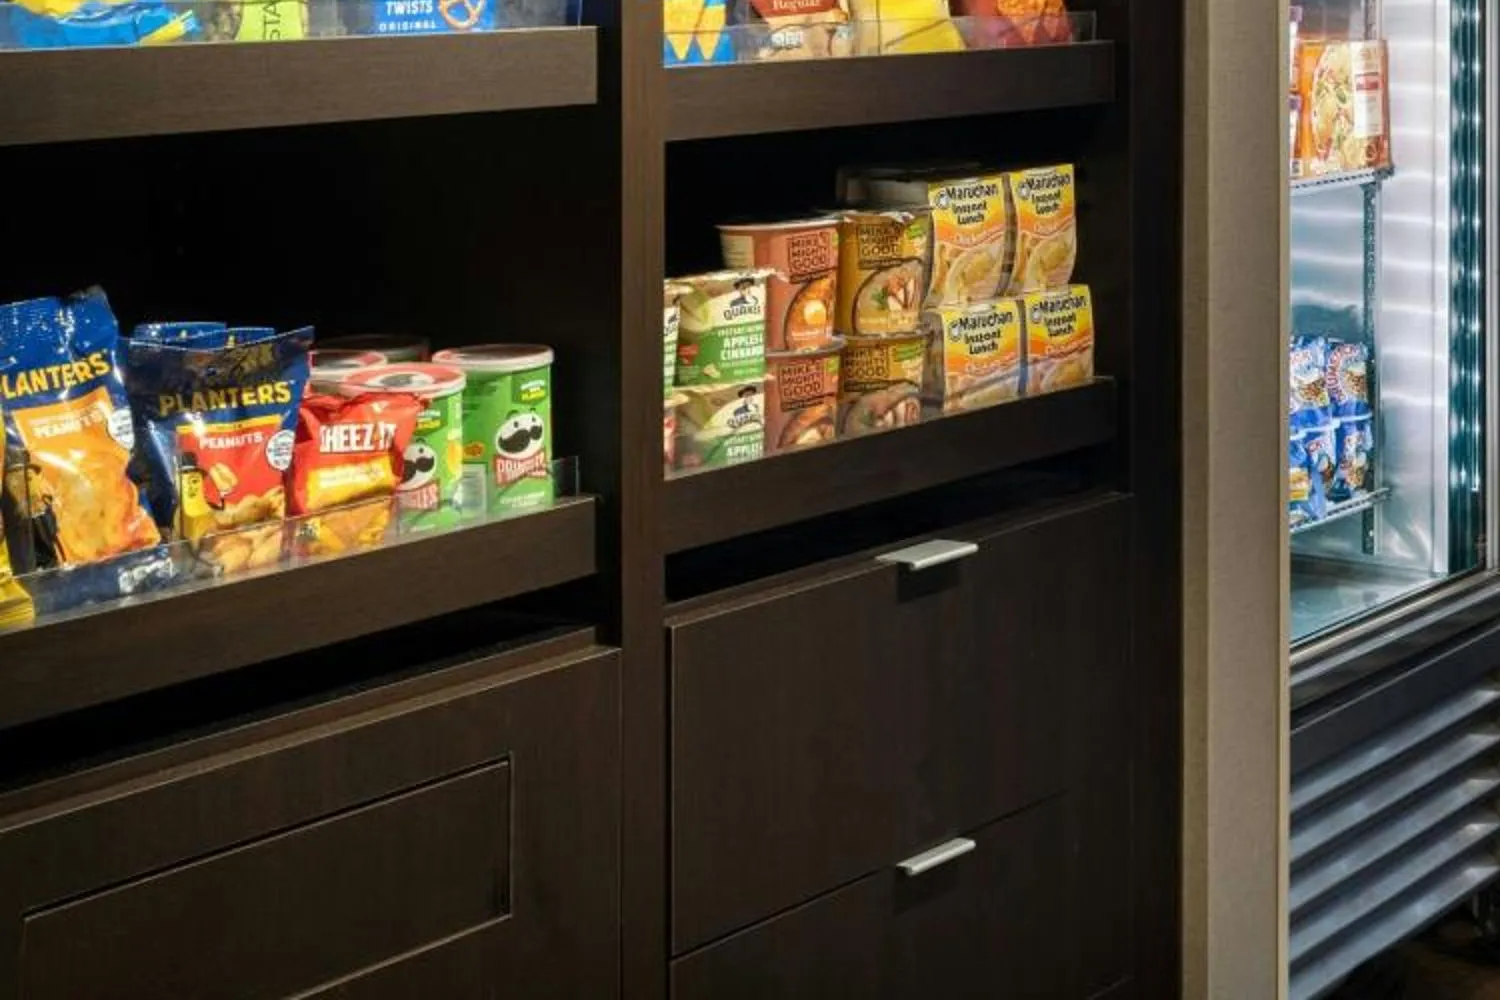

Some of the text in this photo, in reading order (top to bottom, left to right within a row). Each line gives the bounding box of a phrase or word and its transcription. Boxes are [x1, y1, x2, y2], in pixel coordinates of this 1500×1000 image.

[385, 0, 433, 16] TWISTS
[1026, 173, 1071, 190] Maruchan
[946, 182, 998, 200] Maruchan
[952, 201, 987, 214] Instant
[1036, 203, 1060, 215] Lunch
[958, 212, 985, 225] Lunch
[1039, 295, 1086, 313] Maruchan
[959, 311, 1013, 331] Maruchan
[964, 330, 1001, 344] Instant
[1048, 325, 1075, 337] Lunch
[969, 342, 998, 355] Lunch
[0, 353, 110, 400] LANTERS
[160, 382, 292, 418] PLANTERS
[200, 431, 263, 449] PEANUTS
